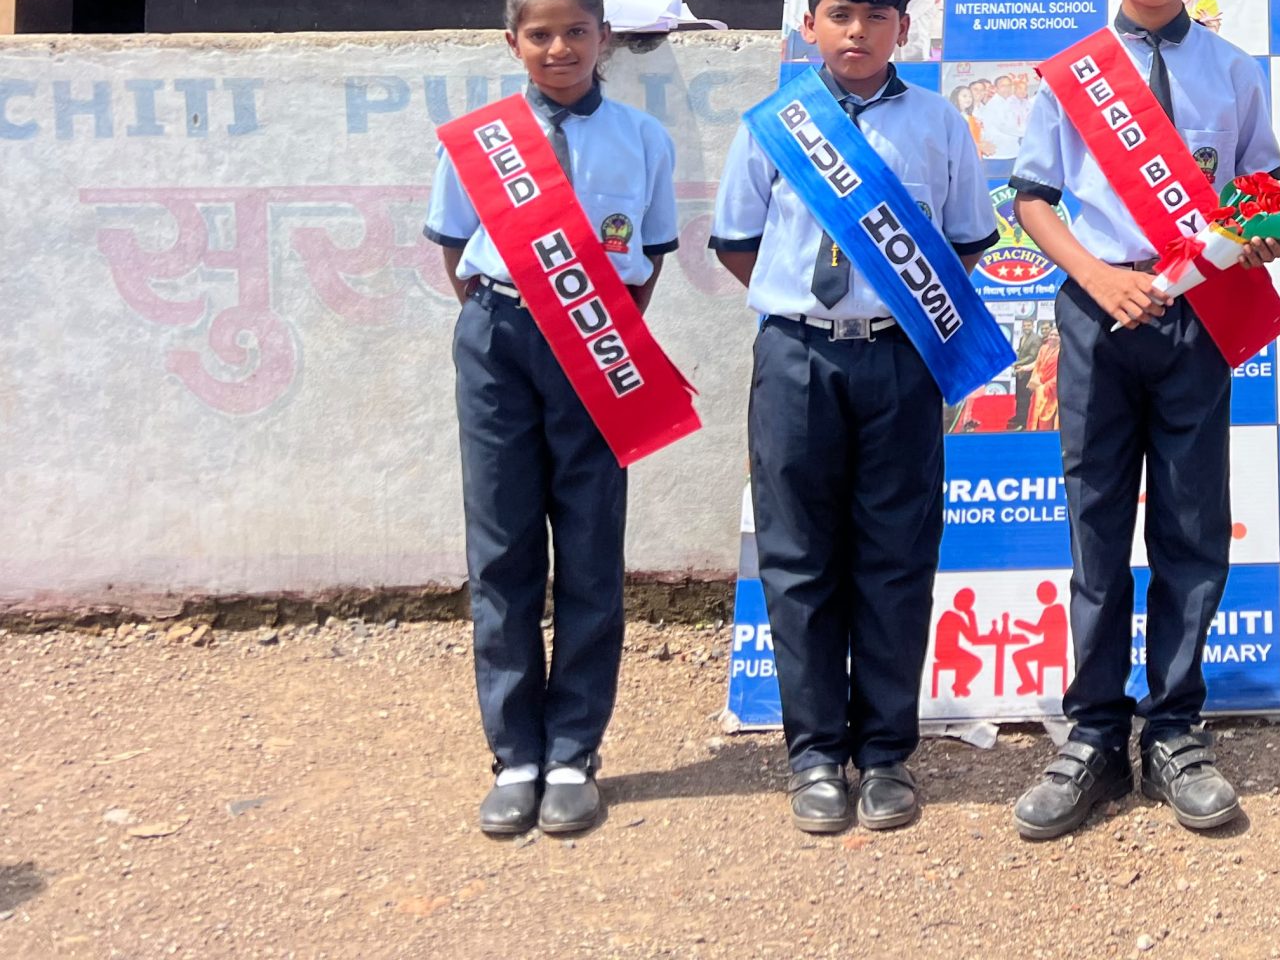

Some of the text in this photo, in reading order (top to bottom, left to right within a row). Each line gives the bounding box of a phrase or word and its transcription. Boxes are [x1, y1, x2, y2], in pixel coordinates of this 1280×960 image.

[955, 1, 1097, 14] INTERNATIONAL SCHOOL
[973, 17, 1078, 30] & JUNIOR SCHOOL
[1075, 61, 1206, 235] HEAD BOY
[780, 103, 960, 339] BLUE HOUSE
[477, 123, 640, 395] RED HOUSE
[983, 249, 1049, 269] PRACHITI
[1000, 506, 1066, 522] COLLE
[1207, 611, 1272, 635] HITI
[1203, 644, 1272, 663] MARY
